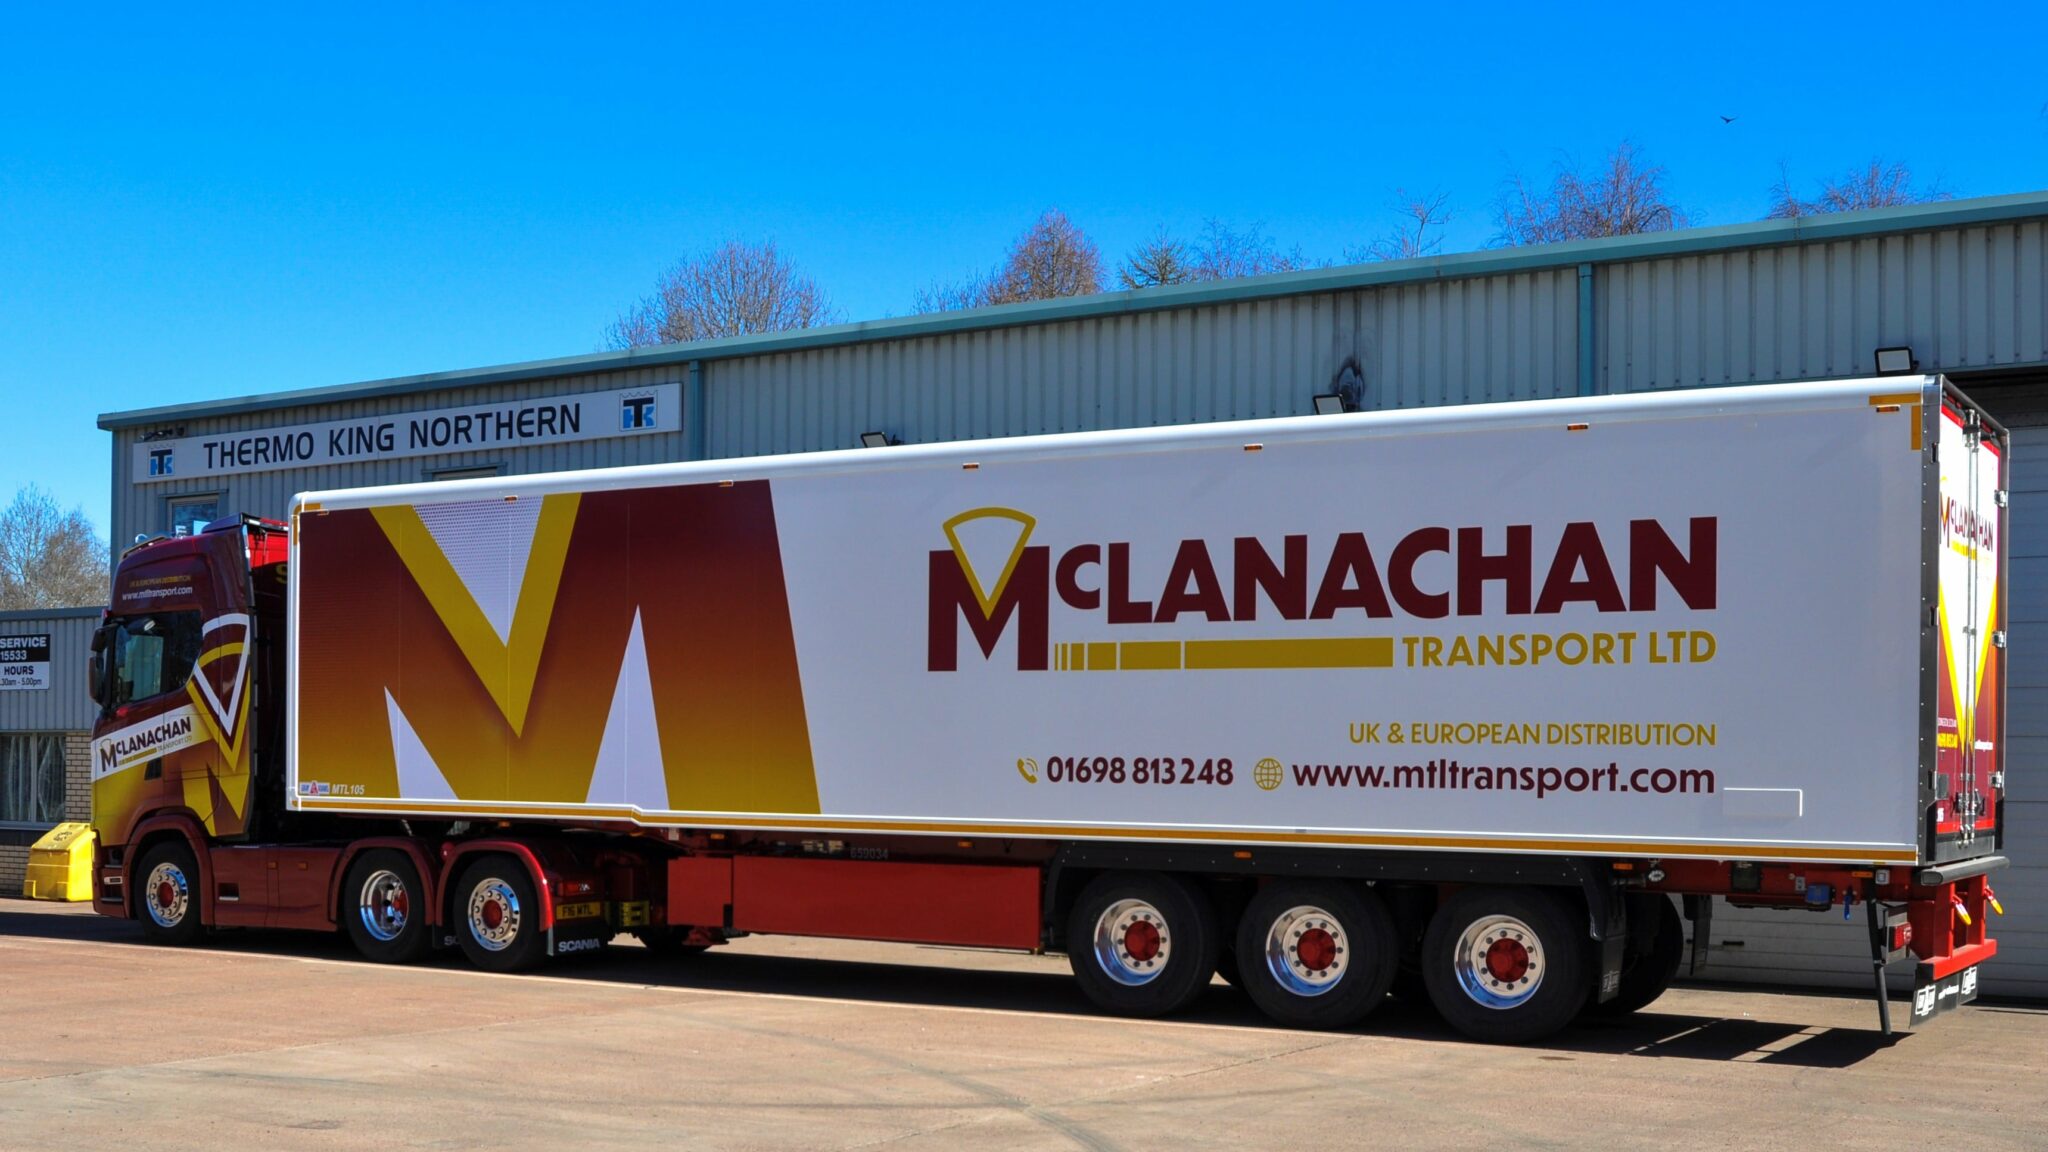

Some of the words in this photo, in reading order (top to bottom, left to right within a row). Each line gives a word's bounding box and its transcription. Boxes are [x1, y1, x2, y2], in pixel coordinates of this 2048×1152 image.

[203, 431, 314, 469] THERMO
[328, 423, 394, 457] KING
[409, 402, 581, 449] NORTHERN
[0, 636, 47, 649] SERVICE
[0, 649, 27, 661] 15533
[1402, 631, 1638, 668] TRANSPORT
[1648, 630, 1718, 664] LTD
[4, 665, 35, 675] HOURS
[1349, 722, 1380, 745] UK
[1386, 722, 1405, 745] &
[1410, 722, 1542, 746] EUROPEAN
[1546, 722, 1717, 748] DISTRIBUTION
[1047, 757, 1126, 784] 01698
[1292, 759, 1715, 799] www.mtltransport.com
[557, 938, 601, 953] SCANIA
